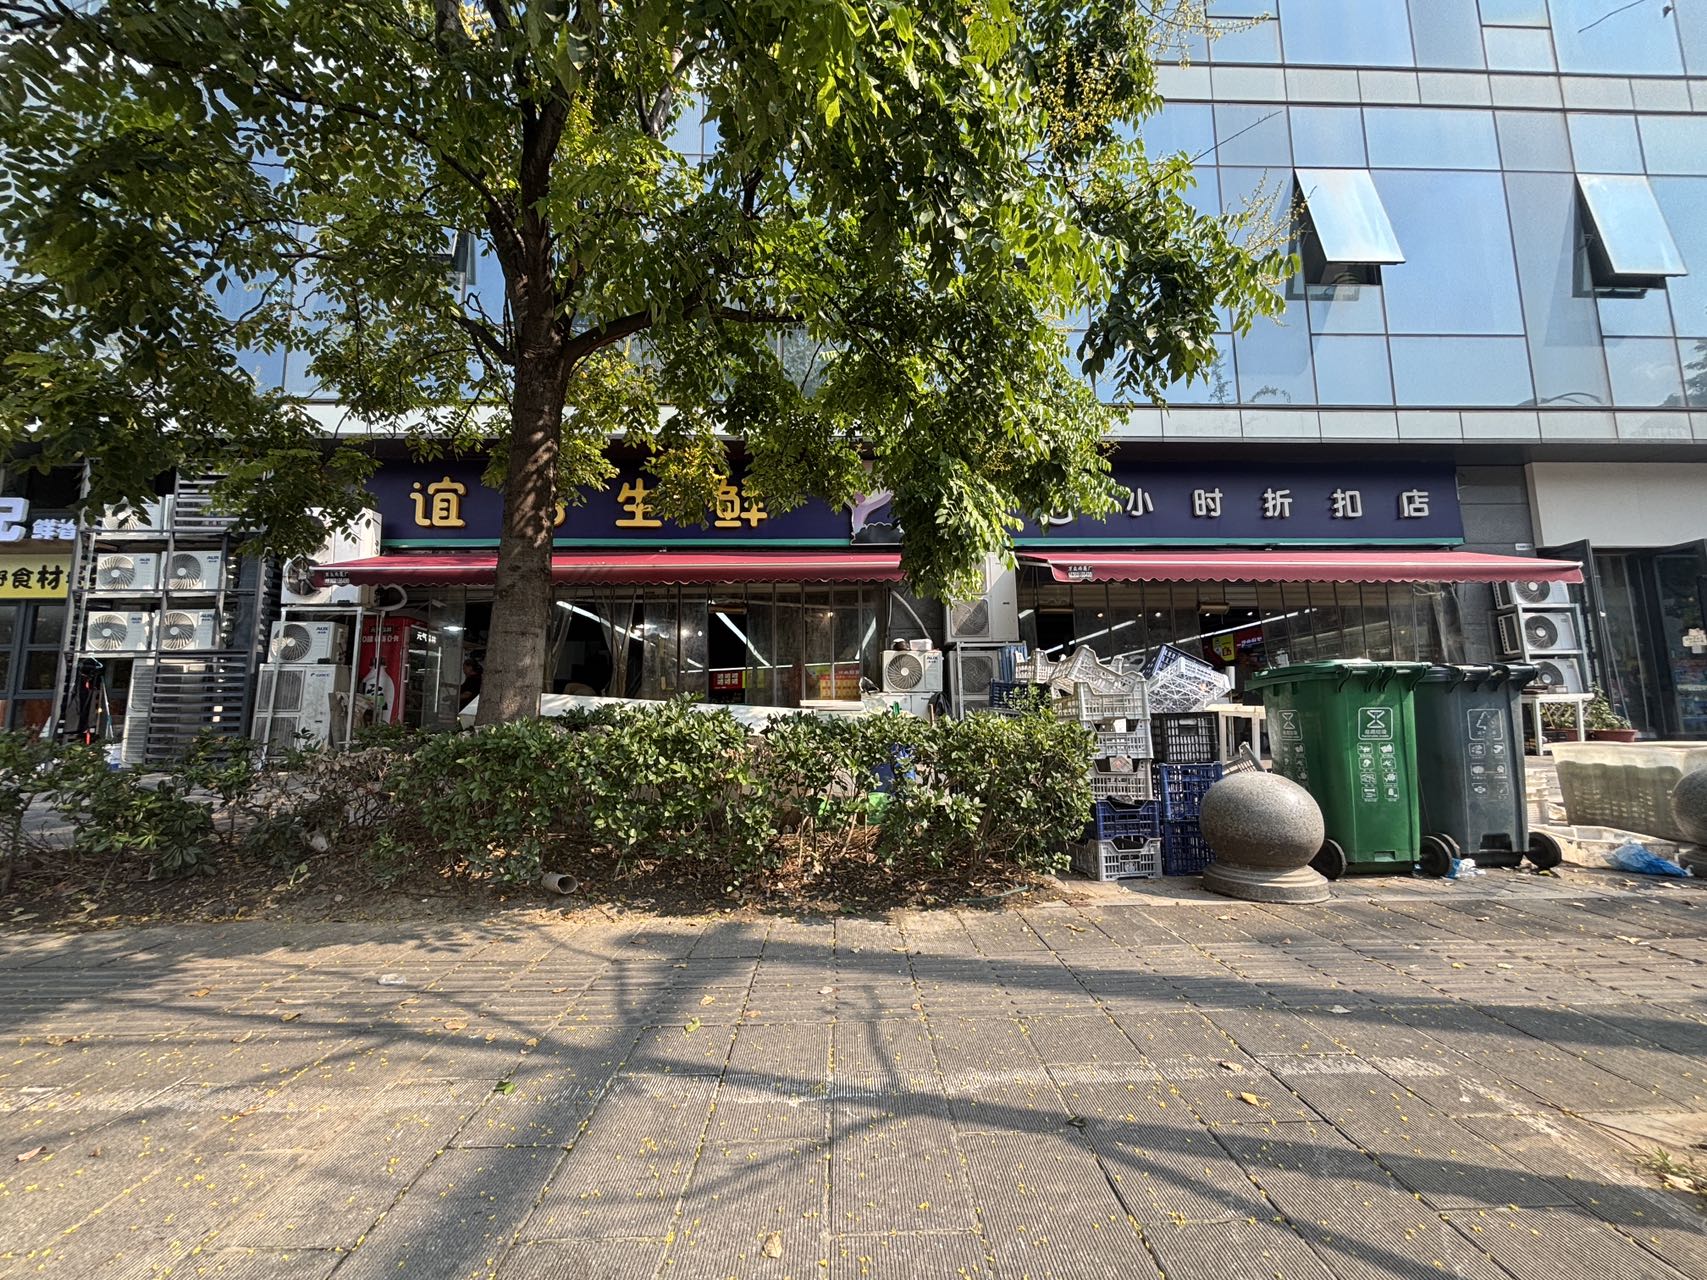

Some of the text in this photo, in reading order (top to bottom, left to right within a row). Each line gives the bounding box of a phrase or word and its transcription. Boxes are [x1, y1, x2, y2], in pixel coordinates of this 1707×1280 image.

[409, 475, 768, 528] 谊生鲜
[1049, 487, 1430, 525] 小时折扣店
[0, 565, 70, 590] 食材
